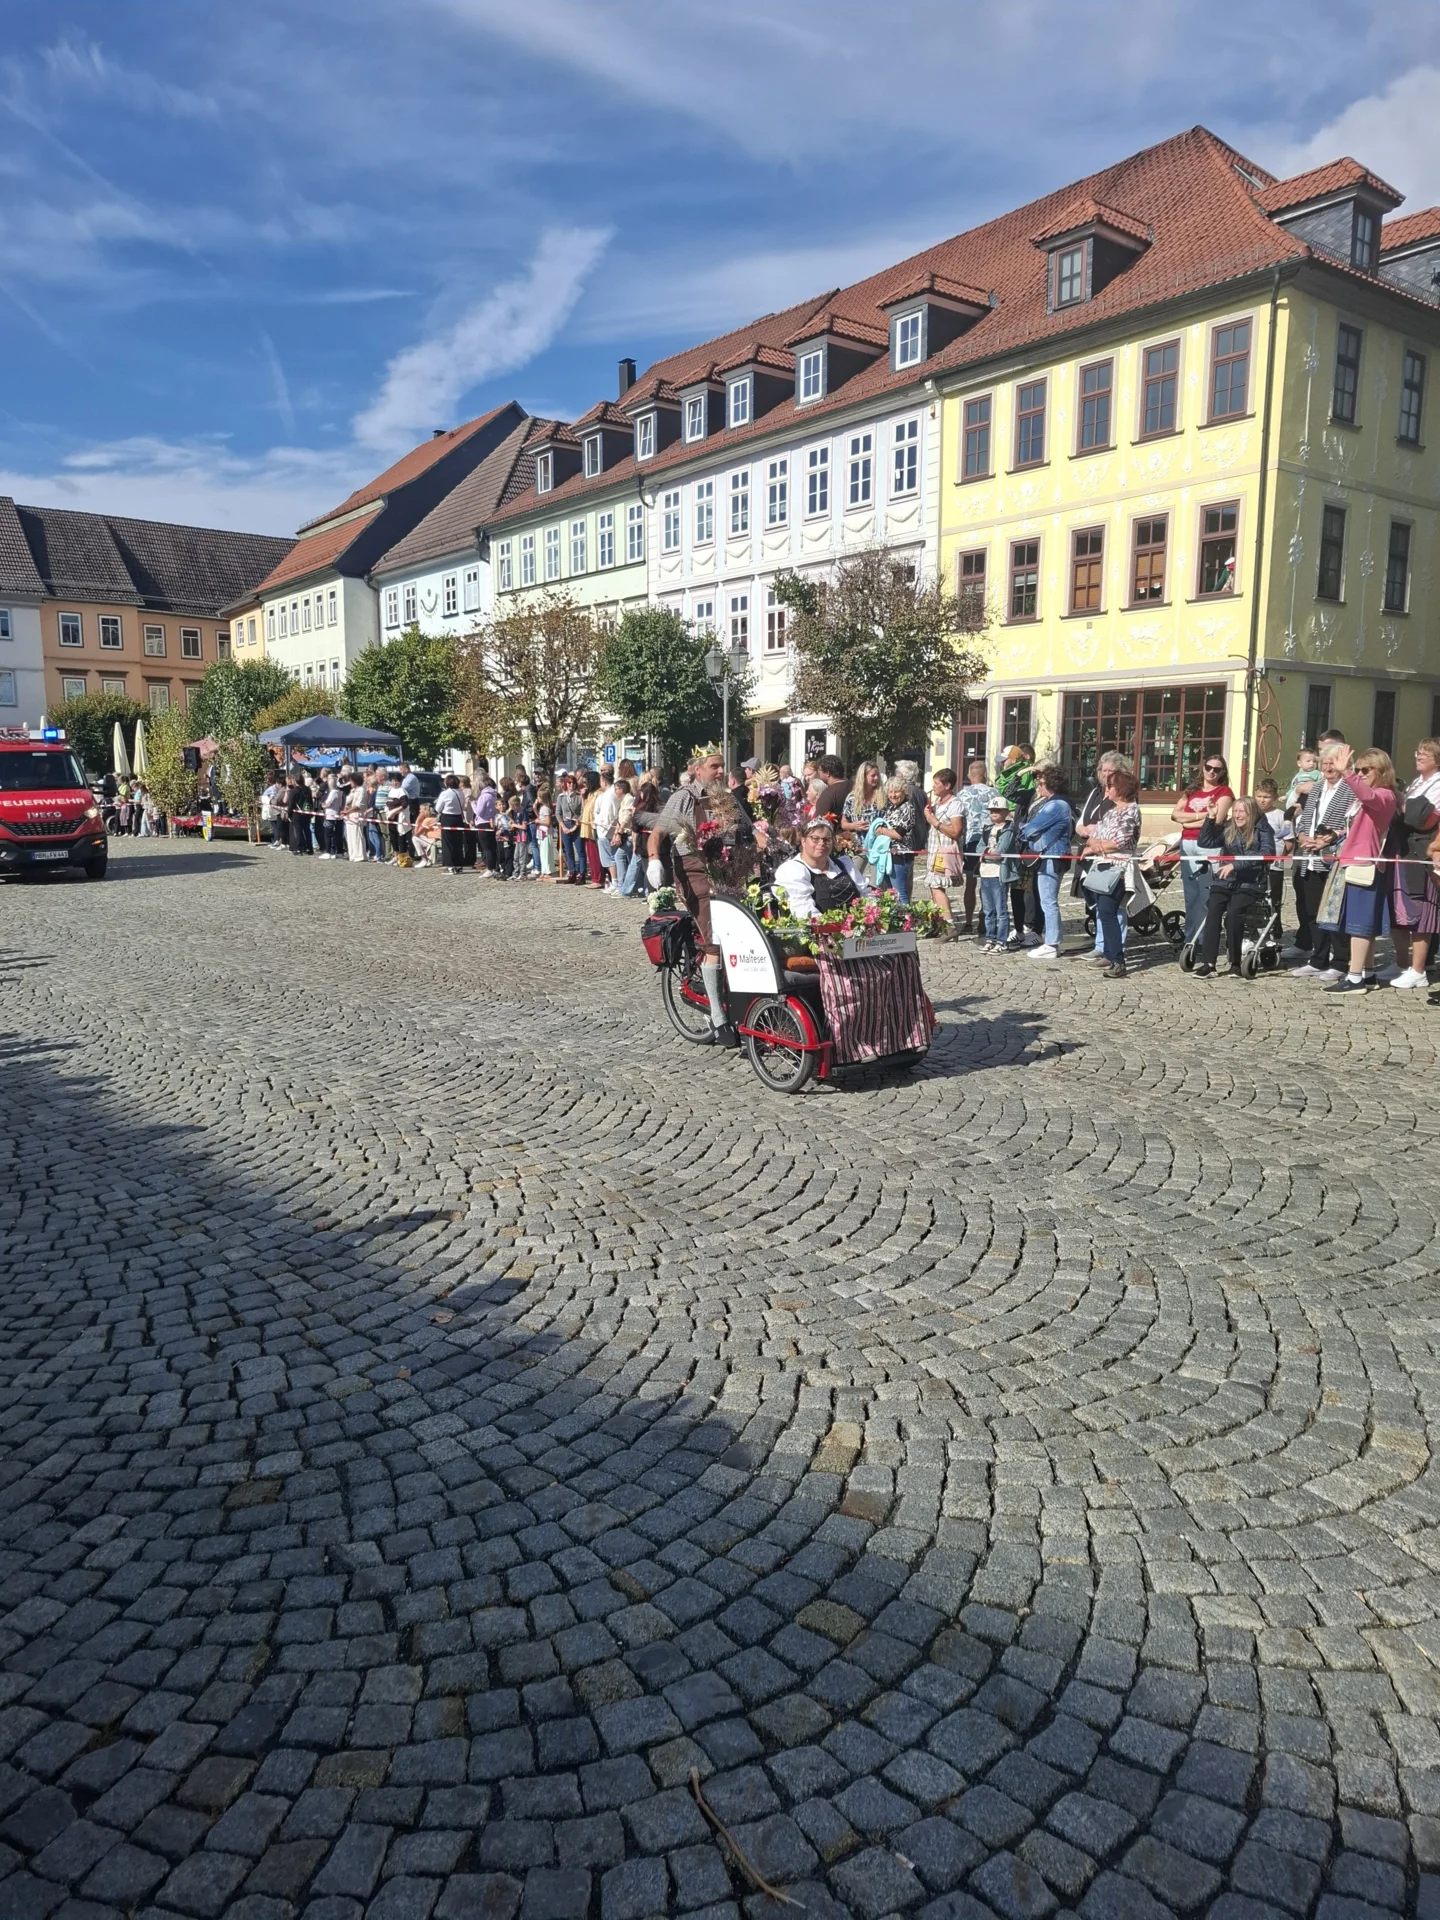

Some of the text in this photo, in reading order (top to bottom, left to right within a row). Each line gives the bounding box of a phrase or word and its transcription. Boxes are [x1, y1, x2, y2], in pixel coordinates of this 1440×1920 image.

[607, 747, 614, 761] P
[0, 797, 86, 807] EUERWEHR
[26, 811, 62, 819] IVECO
[739, 954, 767, 964] Malteser
